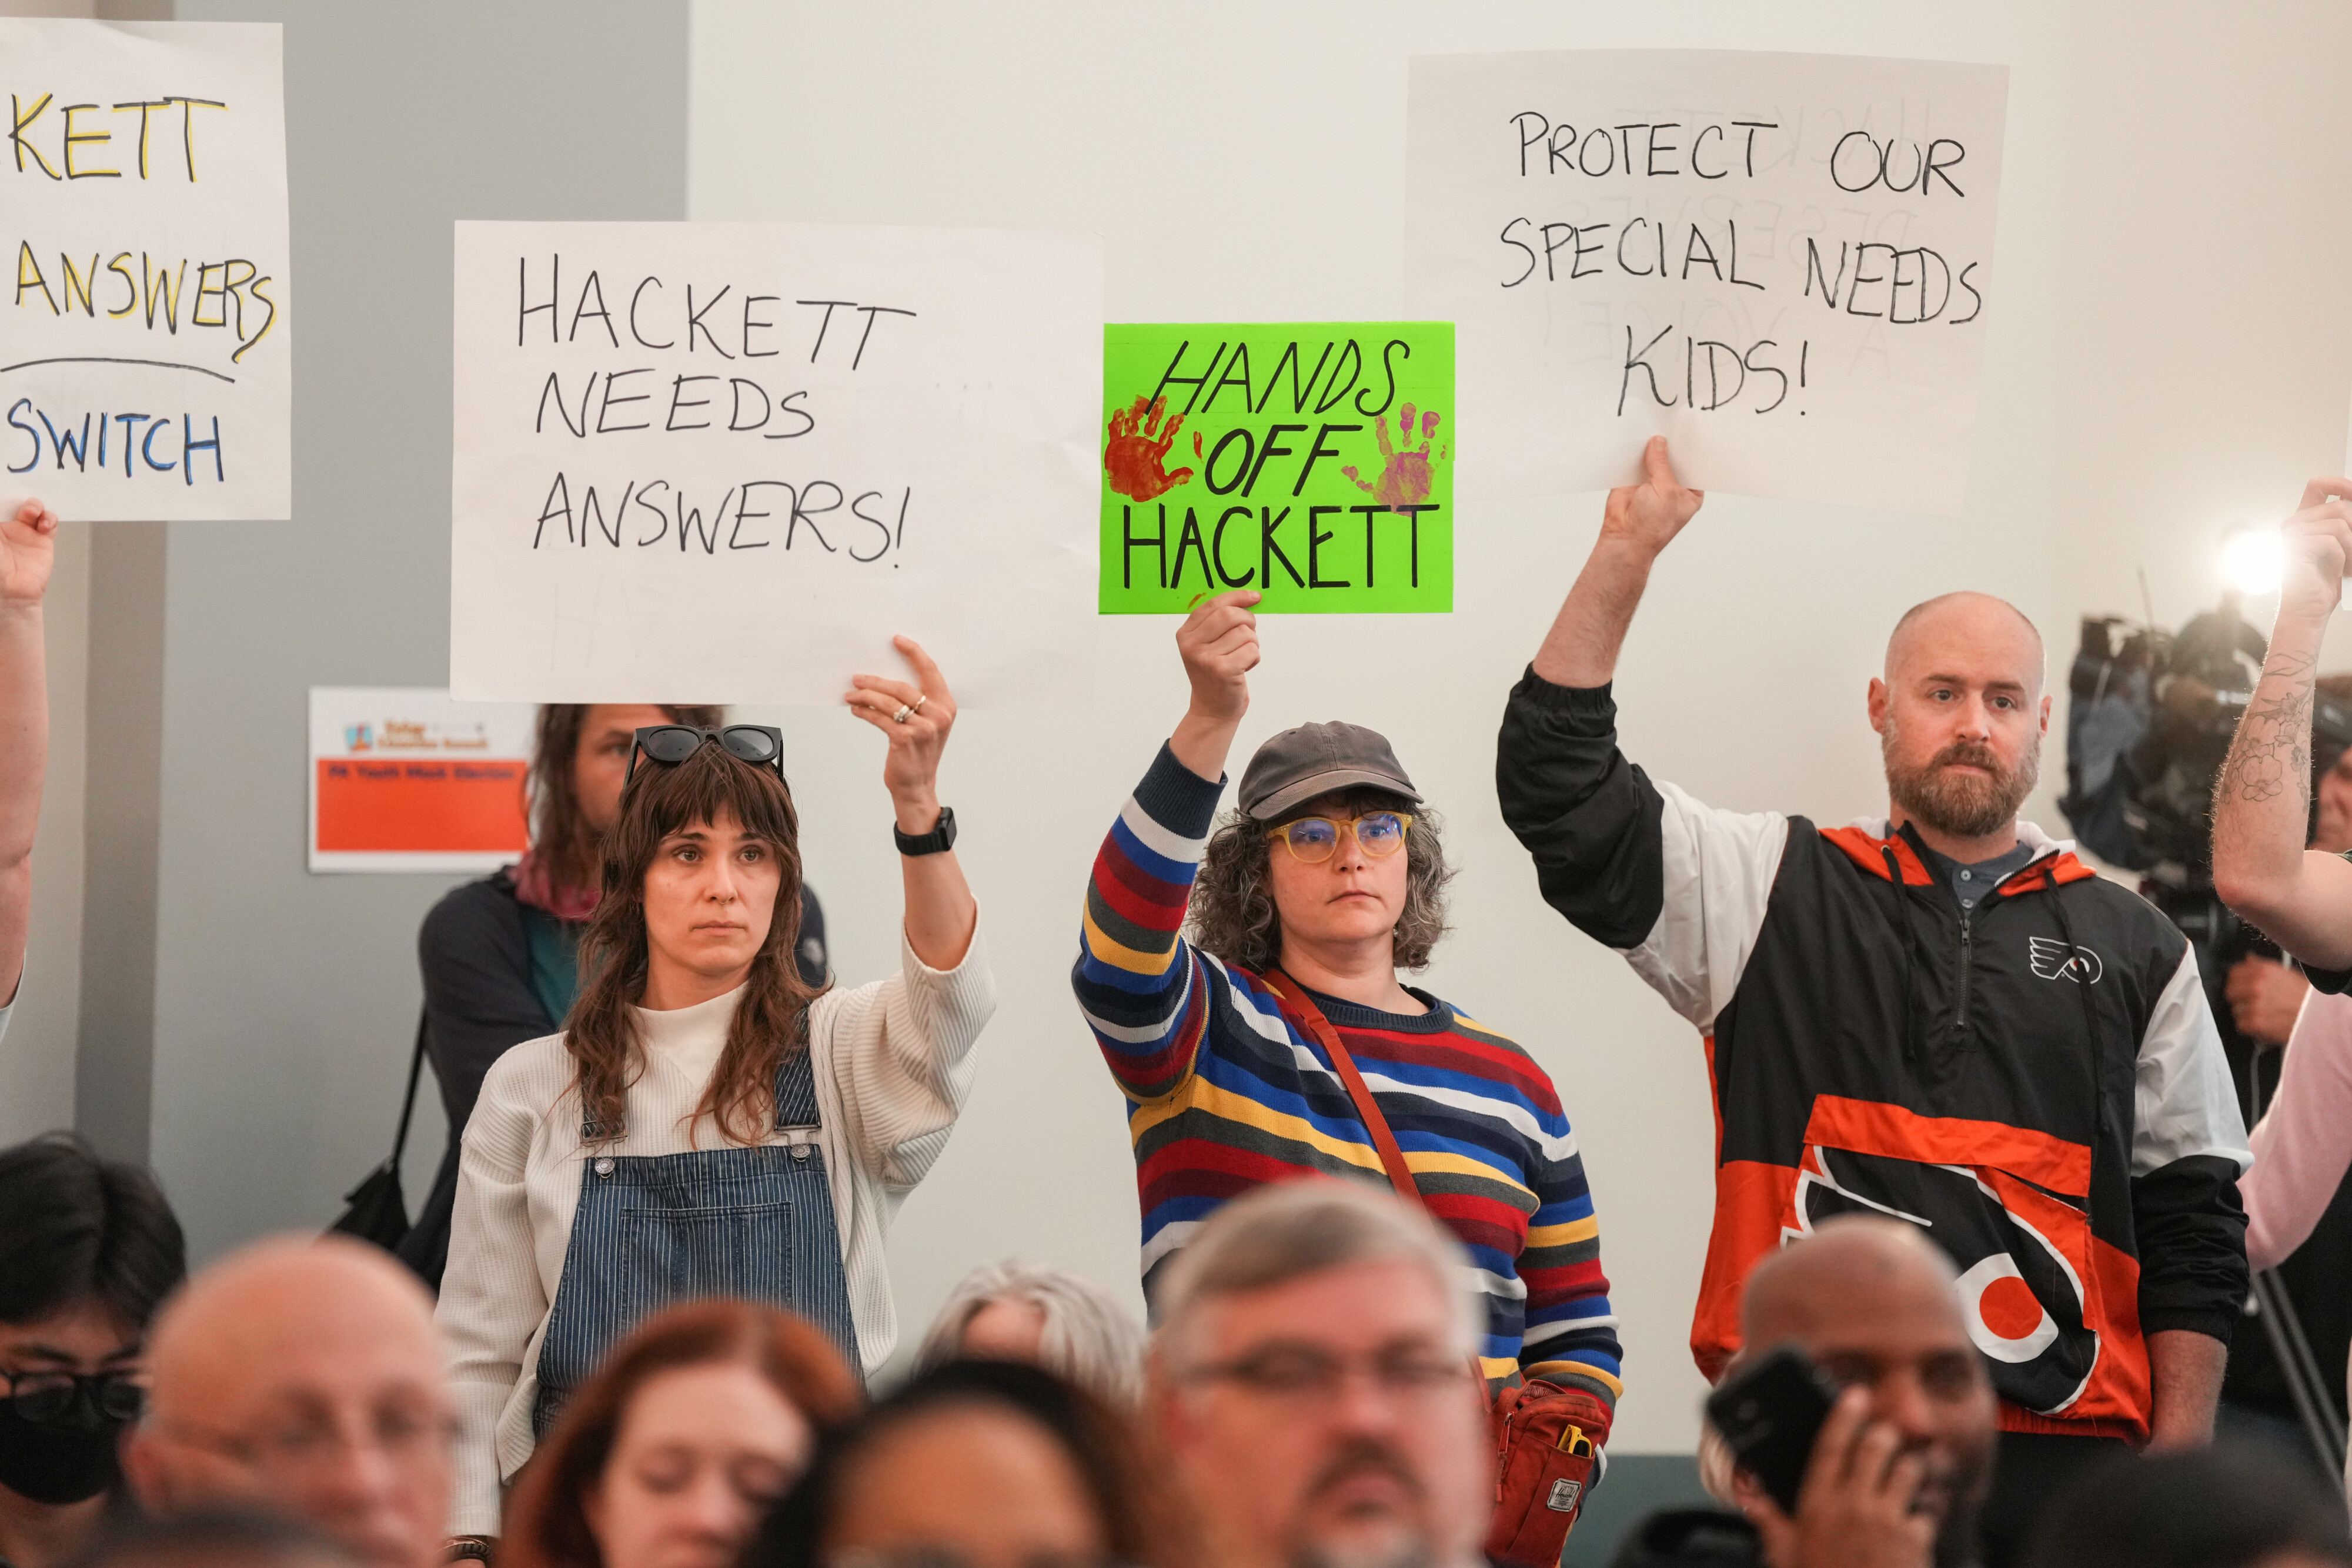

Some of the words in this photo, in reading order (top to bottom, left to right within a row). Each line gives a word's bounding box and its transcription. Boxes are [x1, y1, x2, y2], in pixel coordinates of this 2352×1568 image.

[9, 92, 228, 182] KETT
[1510, 112, 1778, 179] PROTECT
[1830, 131, 1965, 198] OUR
[15, 240, 276, 364] ANSWERS
[519, 253, 917, 370] HACKETT
[1501, 218, 1765, 290] SPECIAL
[1805, 238, 1982, 325] NEEDS
[536, 369, 814, 439] NEEDS
[1144, 339, 1410, 417] HANDS
[1618, 325, 1808, 416] KIDS!
[8, 398, 224, 486] SWITCH
[1205, 423, 1363, 497] OFF
[533, 472, 910, 568] ANSWERS!
[1124, 503, 1440, 589] HACKETT
